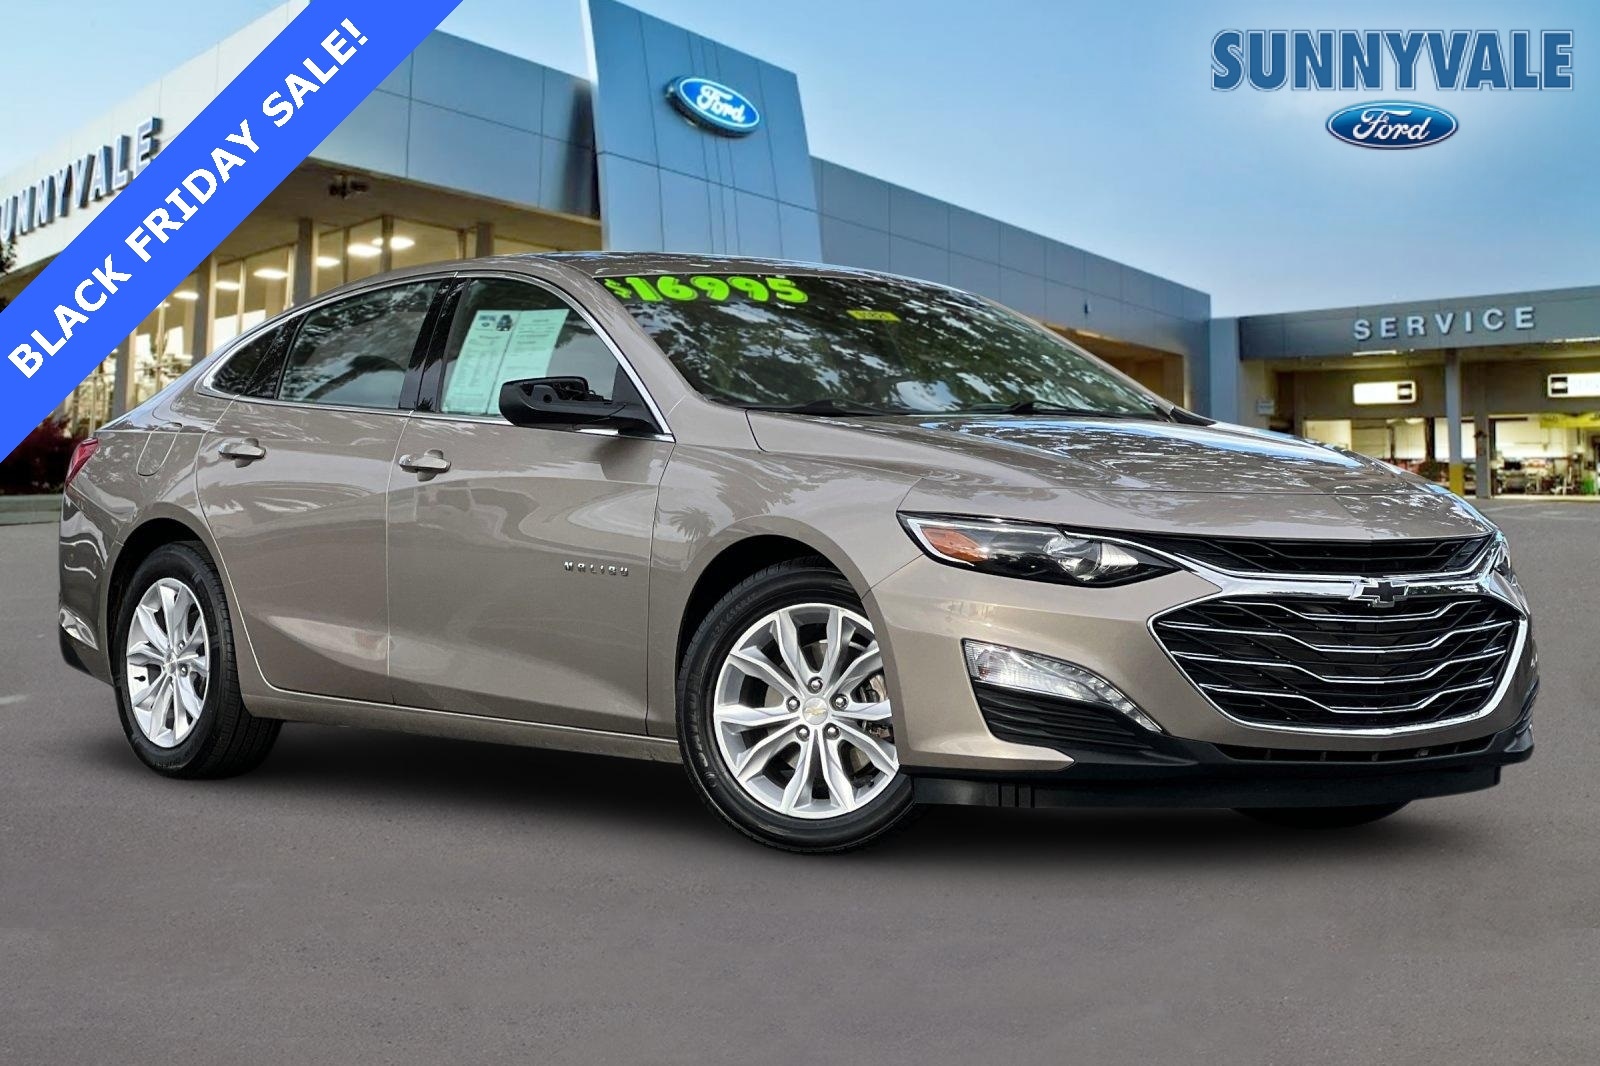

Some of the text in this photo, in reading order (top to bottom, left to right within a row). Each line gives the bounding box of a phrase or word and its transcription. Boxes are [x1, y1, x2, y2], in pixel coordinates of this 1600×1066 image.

[697, 84, 745, 123] Ford
[0, 117, 162, 243] UNNYVALE
[604, 275, 808, 303] $16995
[1353, 305, 1536, 341] SERVICE
[564, 561, 629, 577] MALIBU
